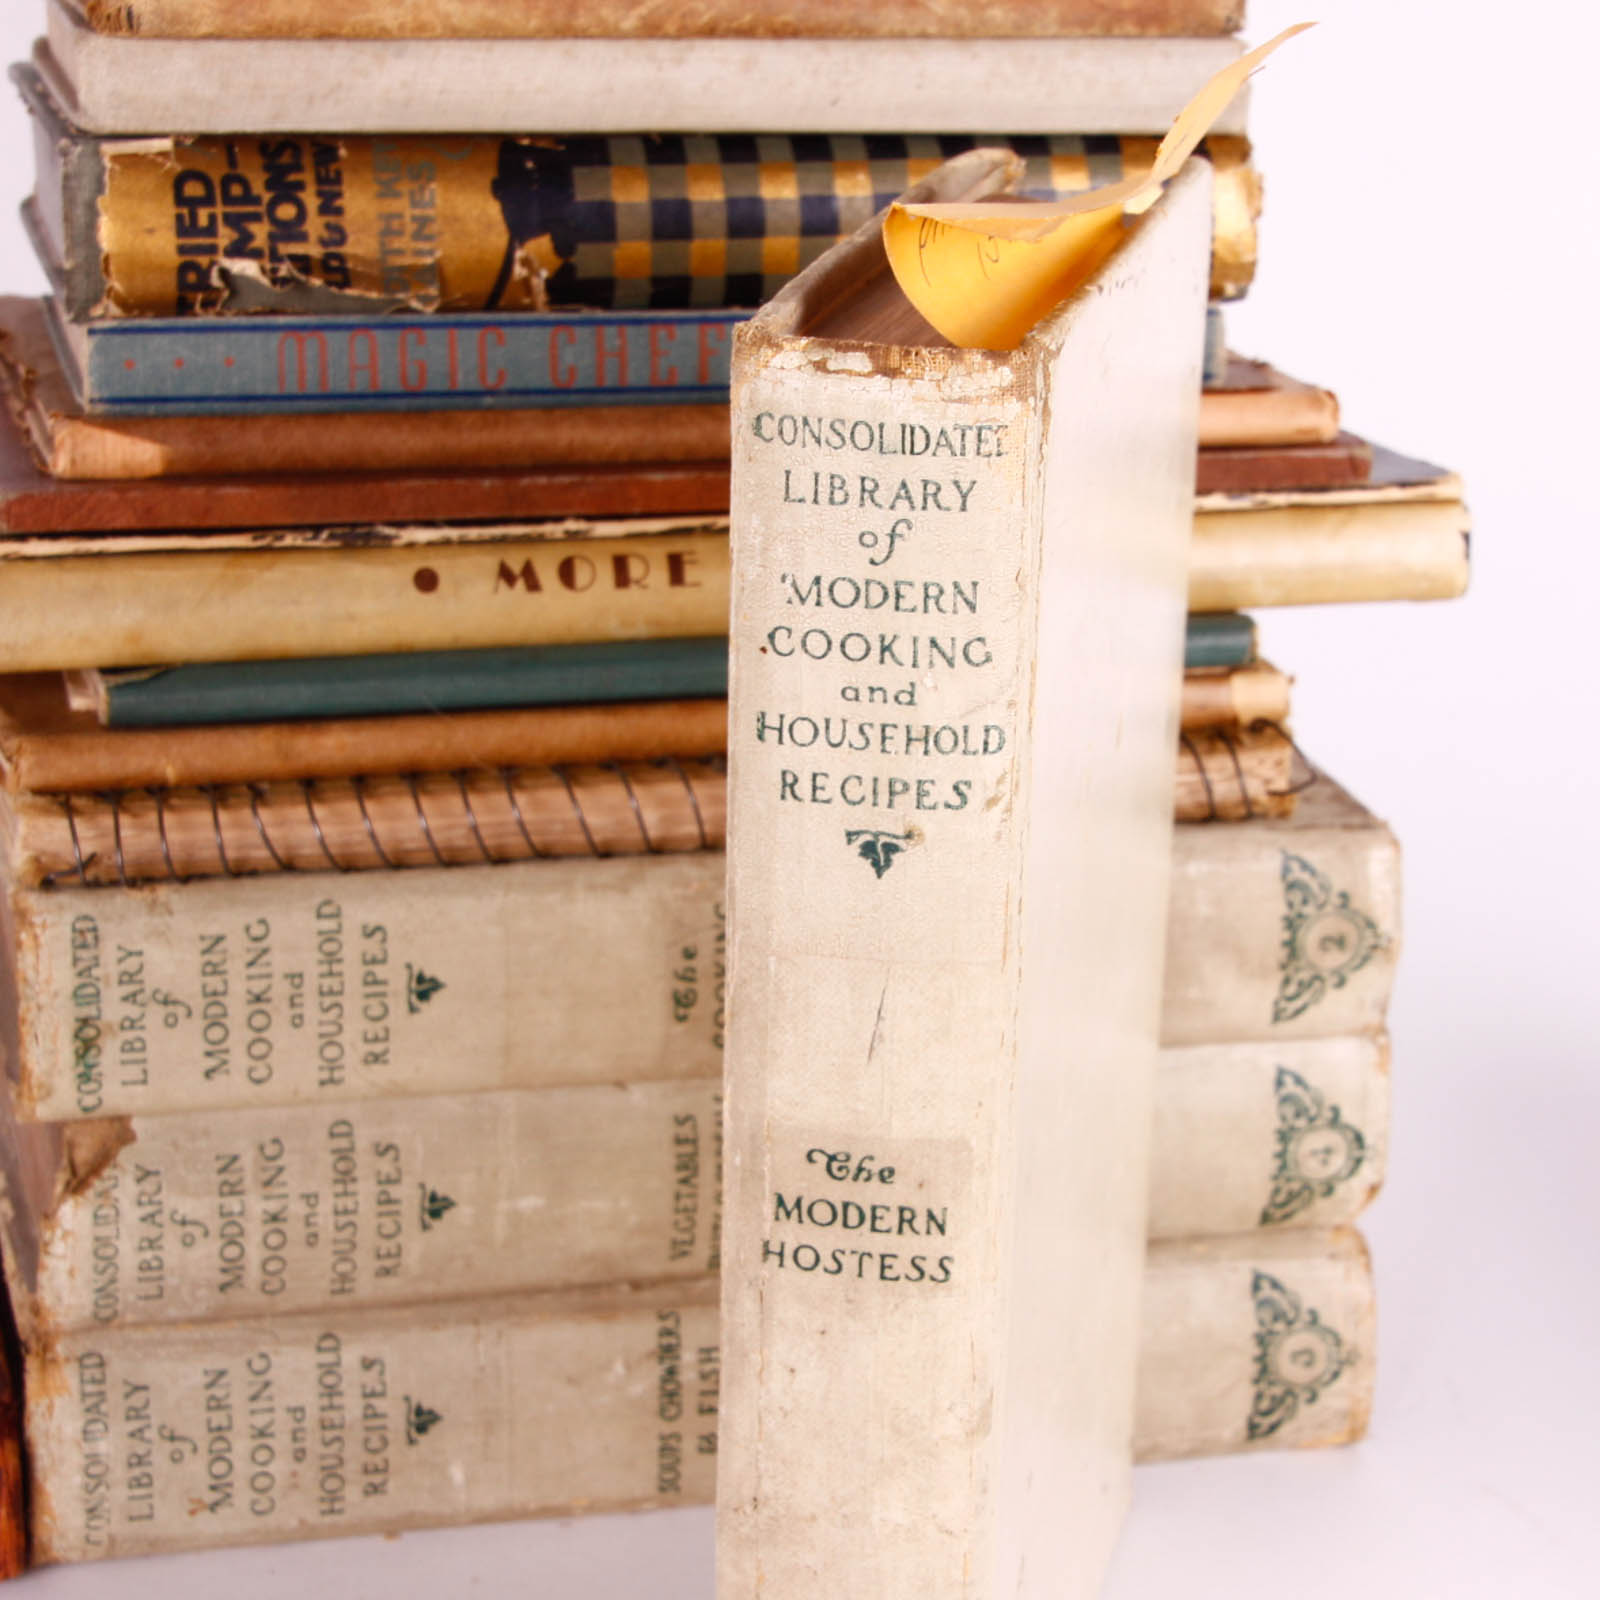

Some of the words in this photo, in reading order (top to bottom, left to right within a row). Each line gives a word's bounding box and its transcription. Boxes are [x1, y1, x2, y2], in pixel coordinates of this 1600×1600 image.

[277, 327, 509, 394] MAGIC
[548, 324, 729, 390] CHEF
[783, 469, 978, 513] LIBRARY
[493, 552, 703, 595] MORE
[858, 518, 913, 567] of
[781, 573, 980, 615] MODERN
[766, 626, 993, 669] COOKING
[841, 682, 918, 707] and
[756, 711, 1007, 757] HOUSEHOLD
[779, 768, 973, 811] RECIPES
[70, 913, 103, 1114] CONSOLIDATED
[116, 943, 148, 1087] LIBRARY
[151, 987, 192, 1028] of
[199, 932, 231, 1081] MODERN
[245, 916, 274, 1086] COOKING
[284, 971, 306, 1029] and
[316, 898, 345, 1088] HOUSEHOLD
[361, 922, 391, 1066] RECIPES
[671, 945, 698, 1024] The
[668, 1113, 699, 1262] VEGETABLES
[806, 1148, 895, 1184] The
[135, 1162, 165, 1301] LIBRARY
[170, 1209, 209, 1249] of
[215, 1152, 246, 1293] MODERN
[259, 1136, 288, 1296] COOKING
[301, 1191, 320, 1248] and
[328, 1119, 358, 1296] HOUSEHOLD
[374, 1140, 403, 1278] RECIPES
[773, 1192, 948, 1236] MODERN
[761, 1239, 954, 1283] HOSTESS
[122, 1378, 155, 1523] LIBRARY
[158, 1423, 198, 1465] of
[203, 1368, 234, 1514] MODERN
[246, 1351, 276, 1517] COOKING
[286, 1404, 306, 1463] and
[315, 1332, 346, 1517] HOUSEHOLD
[361, 1355, 389, 1498] RECIPES
